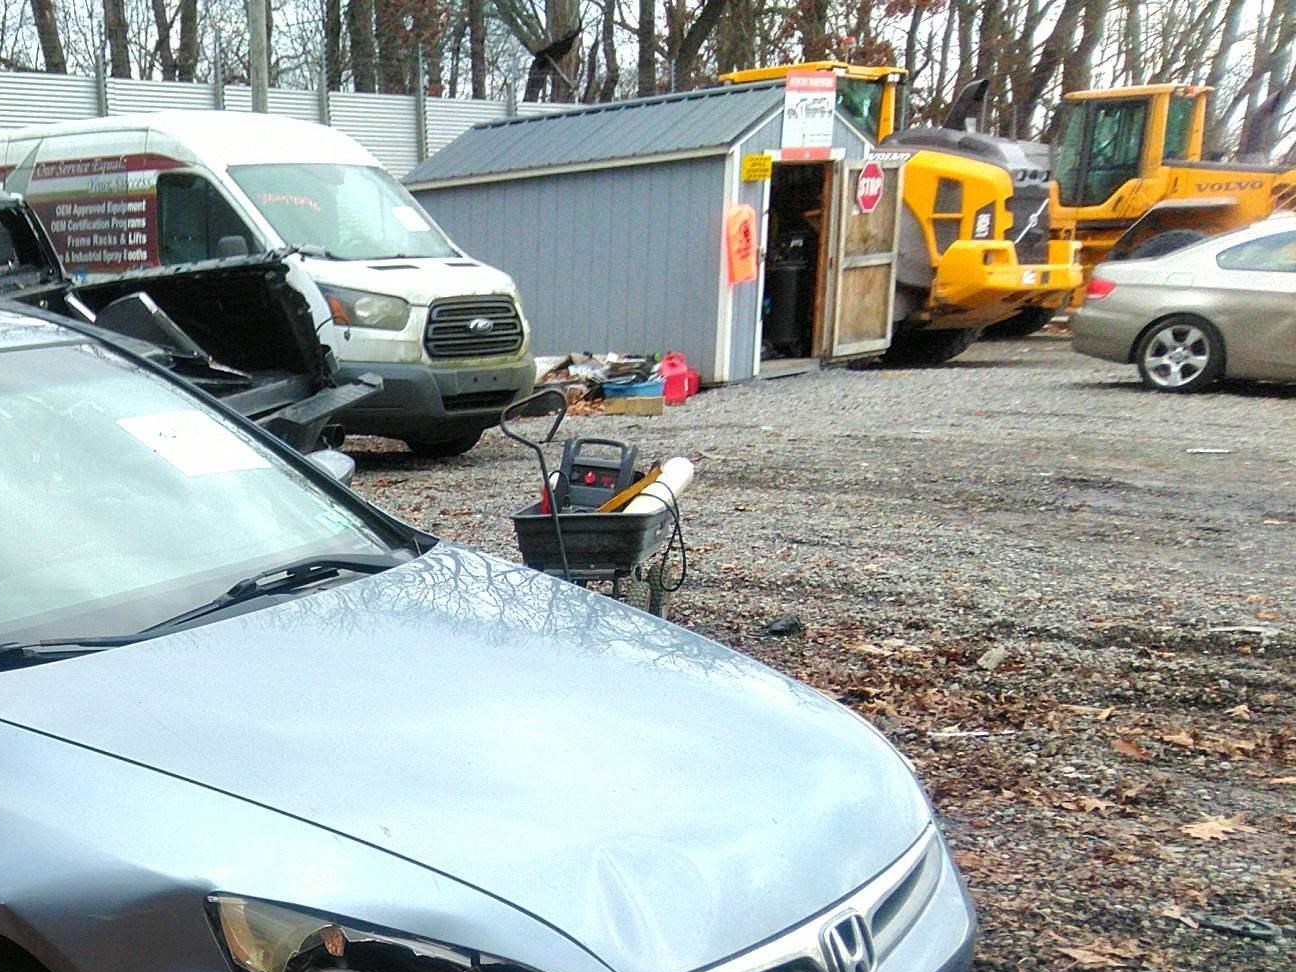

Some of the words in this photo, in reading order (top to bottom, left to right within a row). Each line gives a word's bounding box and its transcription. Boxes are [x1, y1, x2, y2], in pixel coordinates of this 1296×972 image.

[55, 160, 90, 176] Service
[858, 177, 882, 197] STOP
[1194, 180, 1265, 192] VOLVO
[55, 204, 72, 217] OEM
[73, 202, 106, 217] Approved
[107, 199, 146, 215] Equipment
[50, 220, 66, 232] OEM
[67, 219, 110, 232] Certification
[111, 217, 146, 231] Programs
[67, 235, 91, 248] Frame
[93, 233, 117, 246] Racks
[119, 232, 126, 245] &
[128, 231, 147, 245] Lifts
[71, 249, 102, 262] Industrial
[103, 249, 122, 264] Spray
